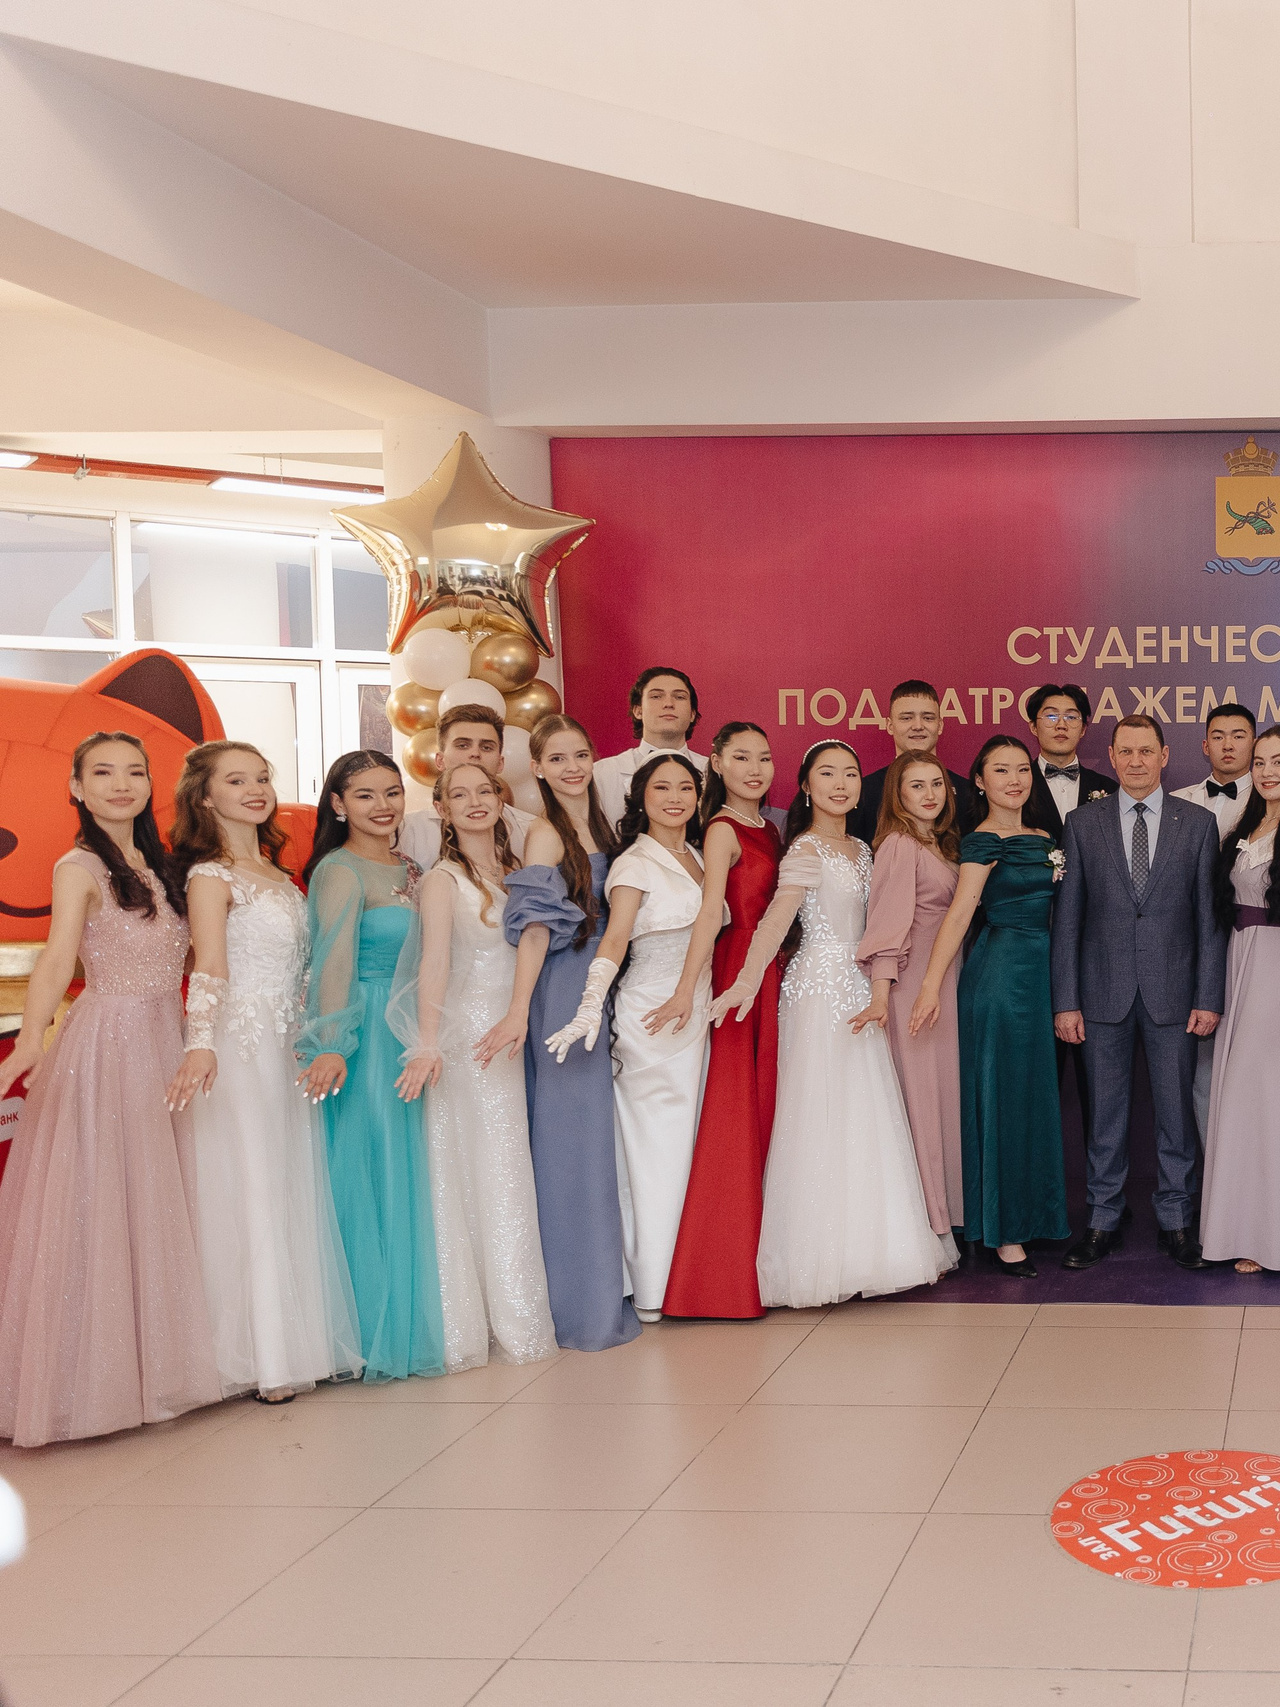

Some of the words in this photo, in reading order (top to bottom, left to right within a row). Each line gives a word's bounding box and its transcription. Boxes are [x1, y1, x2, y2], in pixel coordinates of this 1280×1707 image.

[778, 687, 887, 731] ПОД
[0, 1111, 19, 1126] анк
[1077, 1535, 1121, 1561] ЗАЛ
